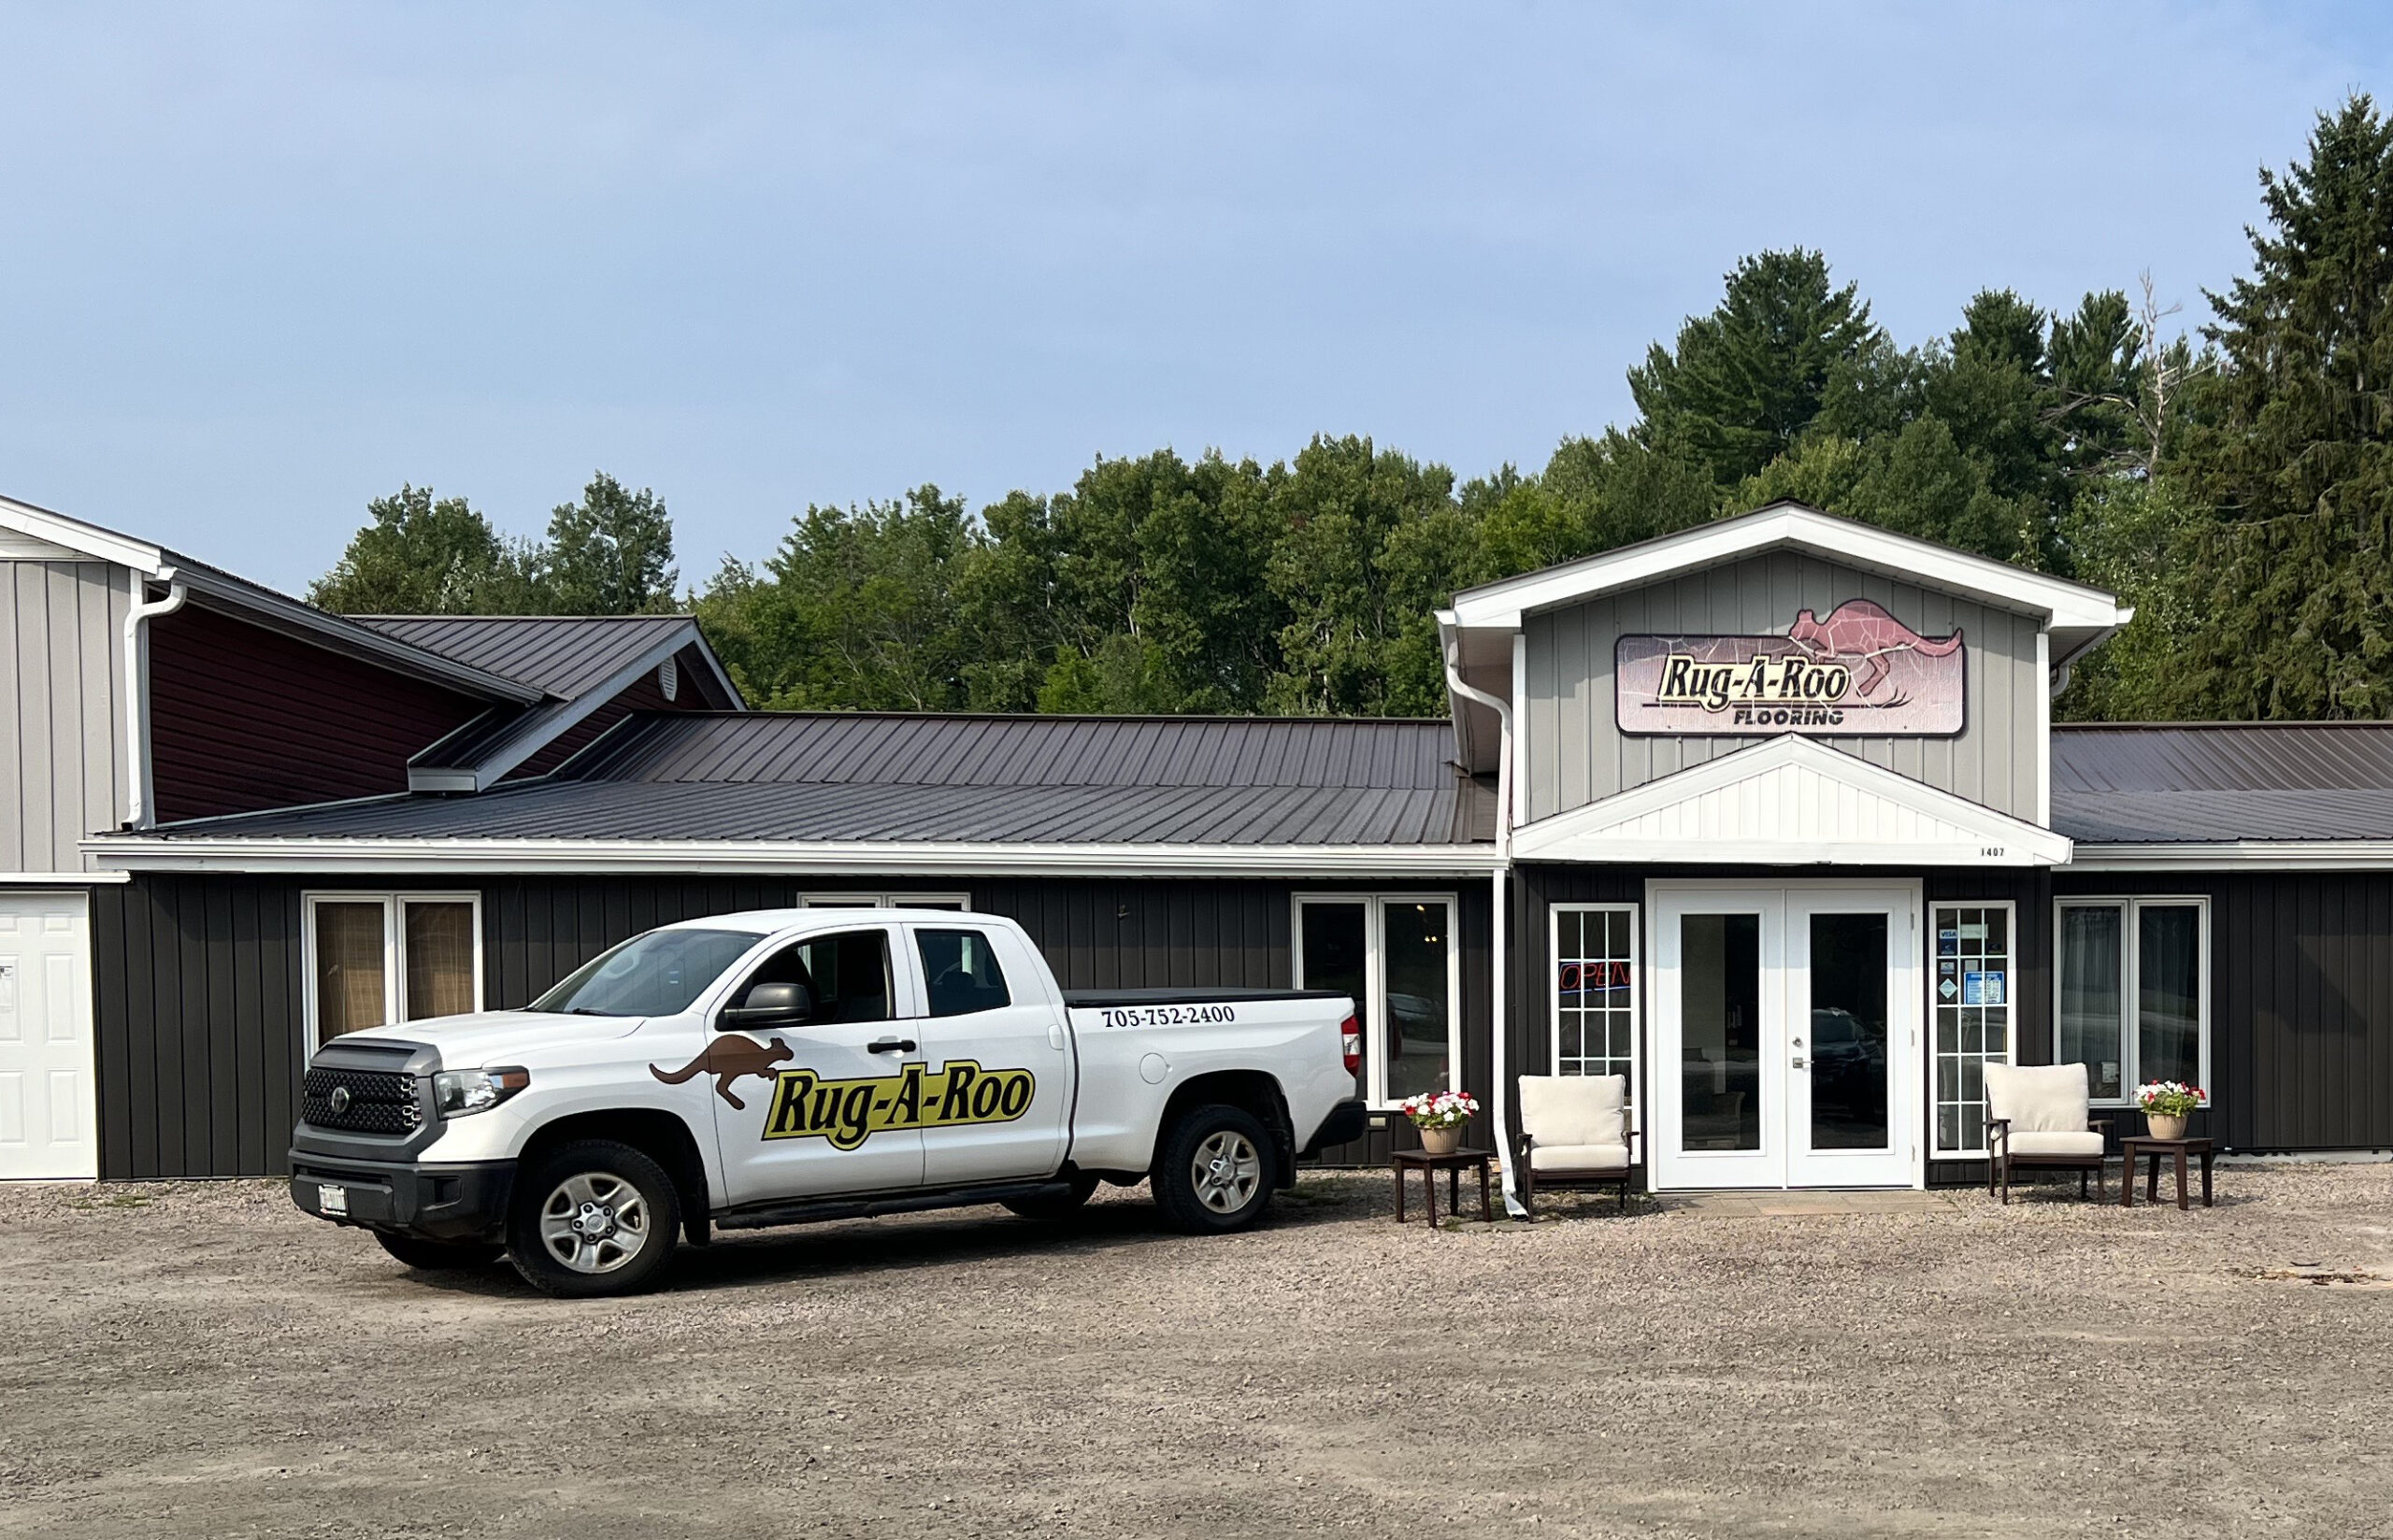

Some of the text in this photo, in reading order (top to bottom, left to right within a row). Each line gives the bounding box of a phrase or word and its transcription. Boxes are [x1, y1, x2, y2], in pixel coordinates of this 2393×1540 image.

[1663, 658, 1847, 709] Rug-A-Roo
[1734, 709, 1844, 726] FLOORING
[1981, 847, 2004, 857] 1407
[1561, 962, 1630, 989] OPEN
[1101, 1005, 1235, 1028] 705-752-2400
[771, 1064, 1027, 1144] Rug-A-Roo
